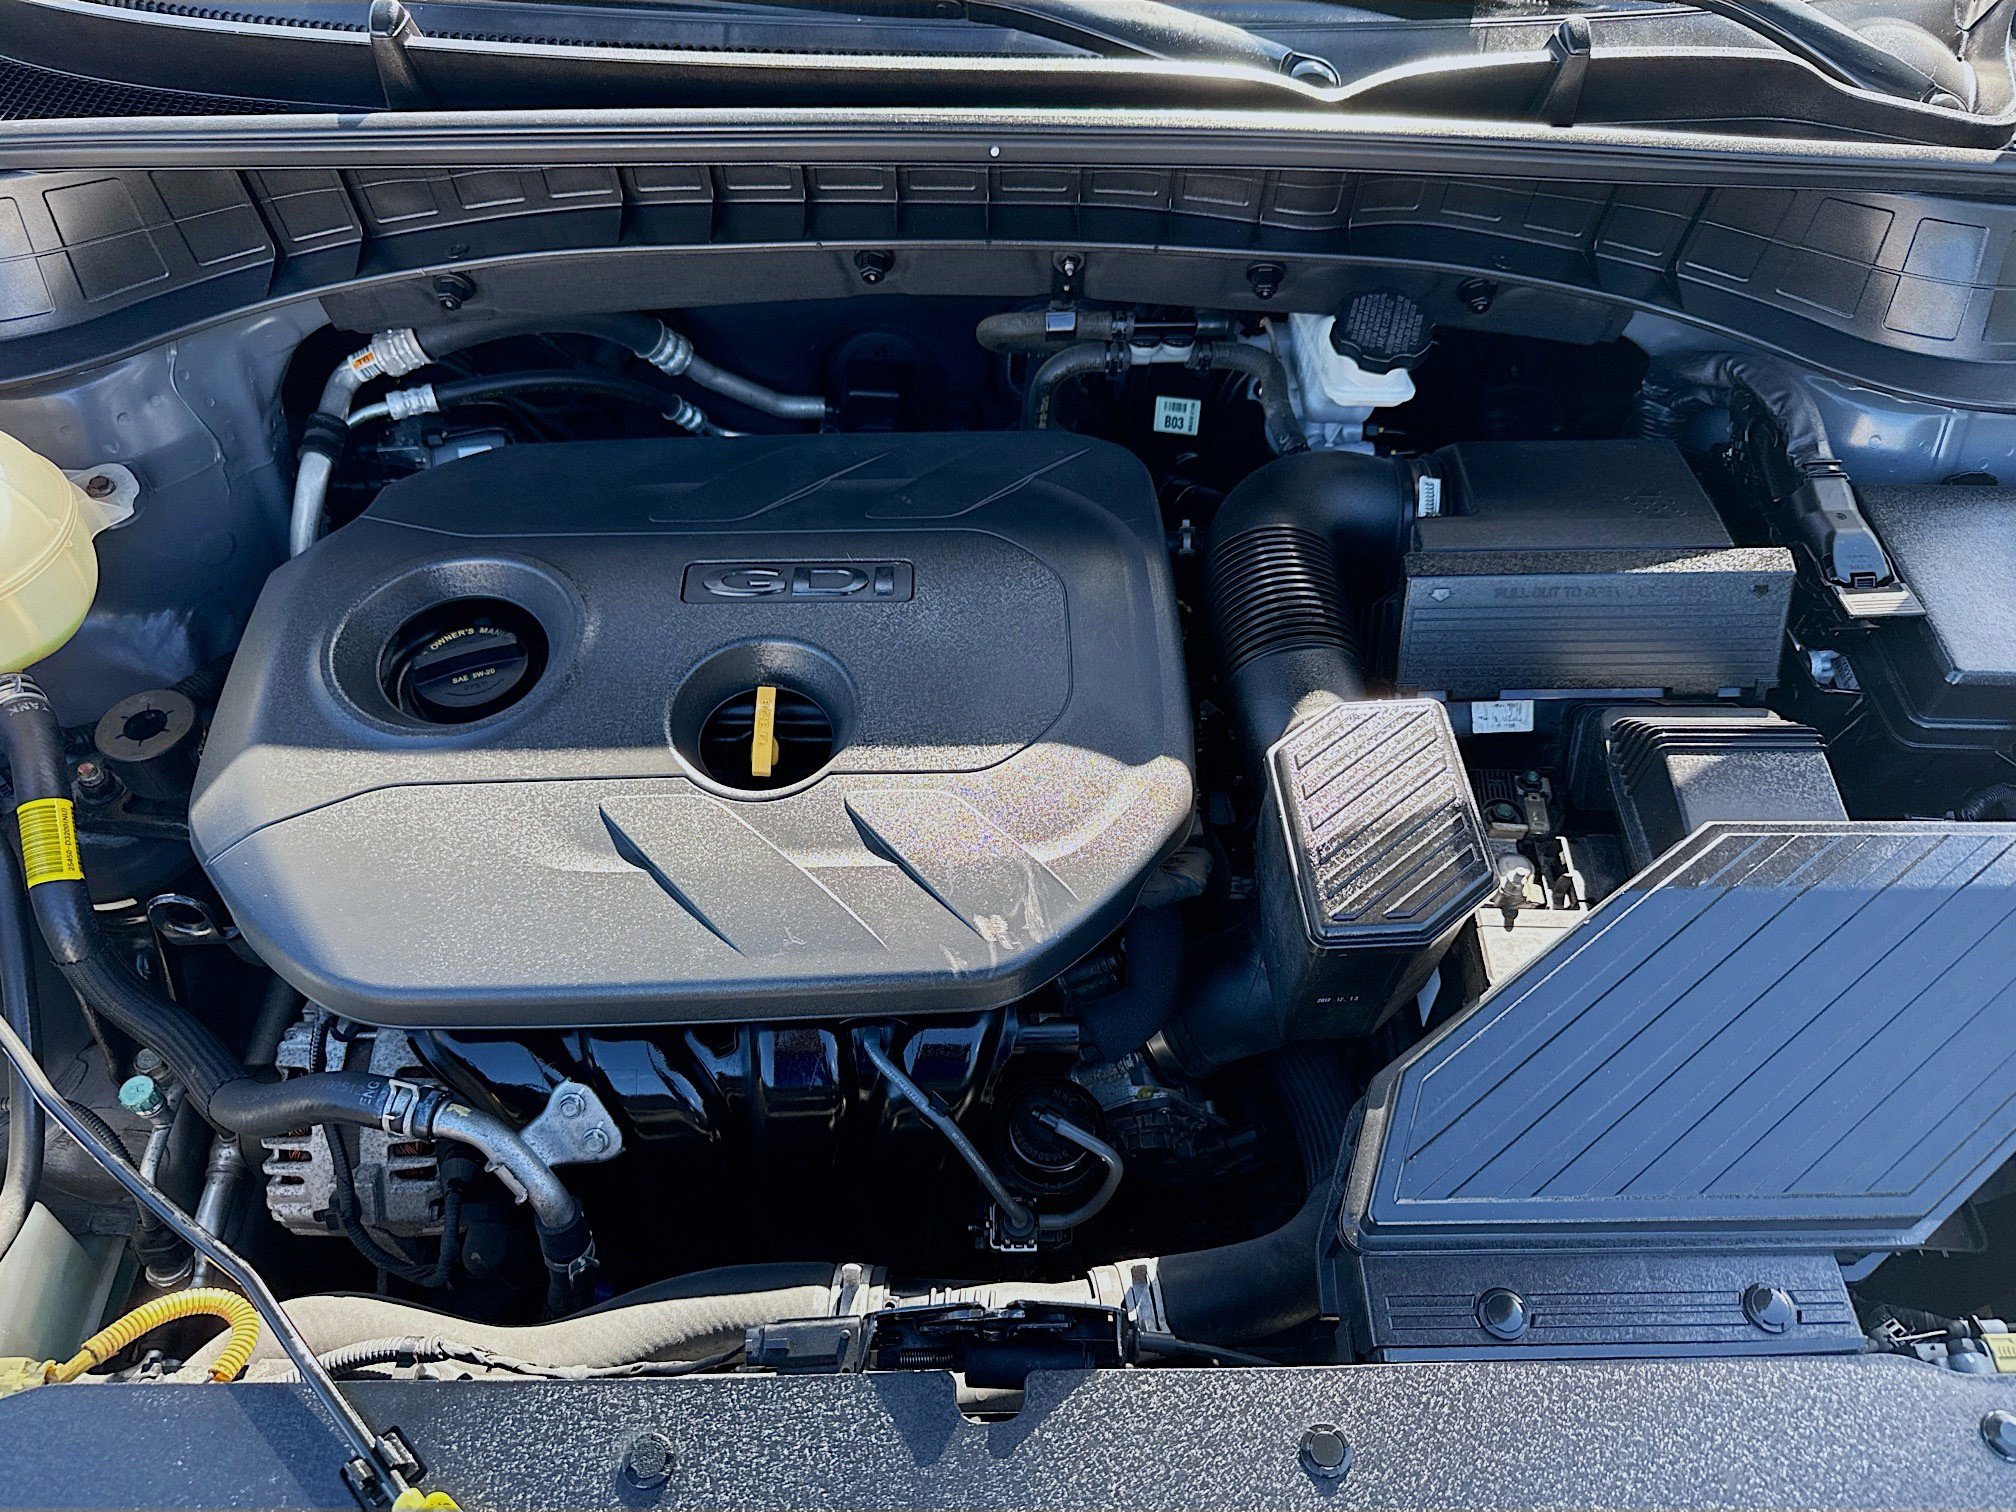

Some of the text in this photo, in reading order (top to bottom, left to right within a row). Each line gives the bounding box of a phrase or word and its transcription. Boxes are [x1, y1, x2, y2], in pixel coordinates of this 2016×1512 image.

[1164, 416, 1184, 430] B03
[703, 566, 895, 597] GDI
[430, 628, 475, 650] OWNER'S
[452, 675, 469, 685] SAE
[359, 1080, 381, 1107] ENG
